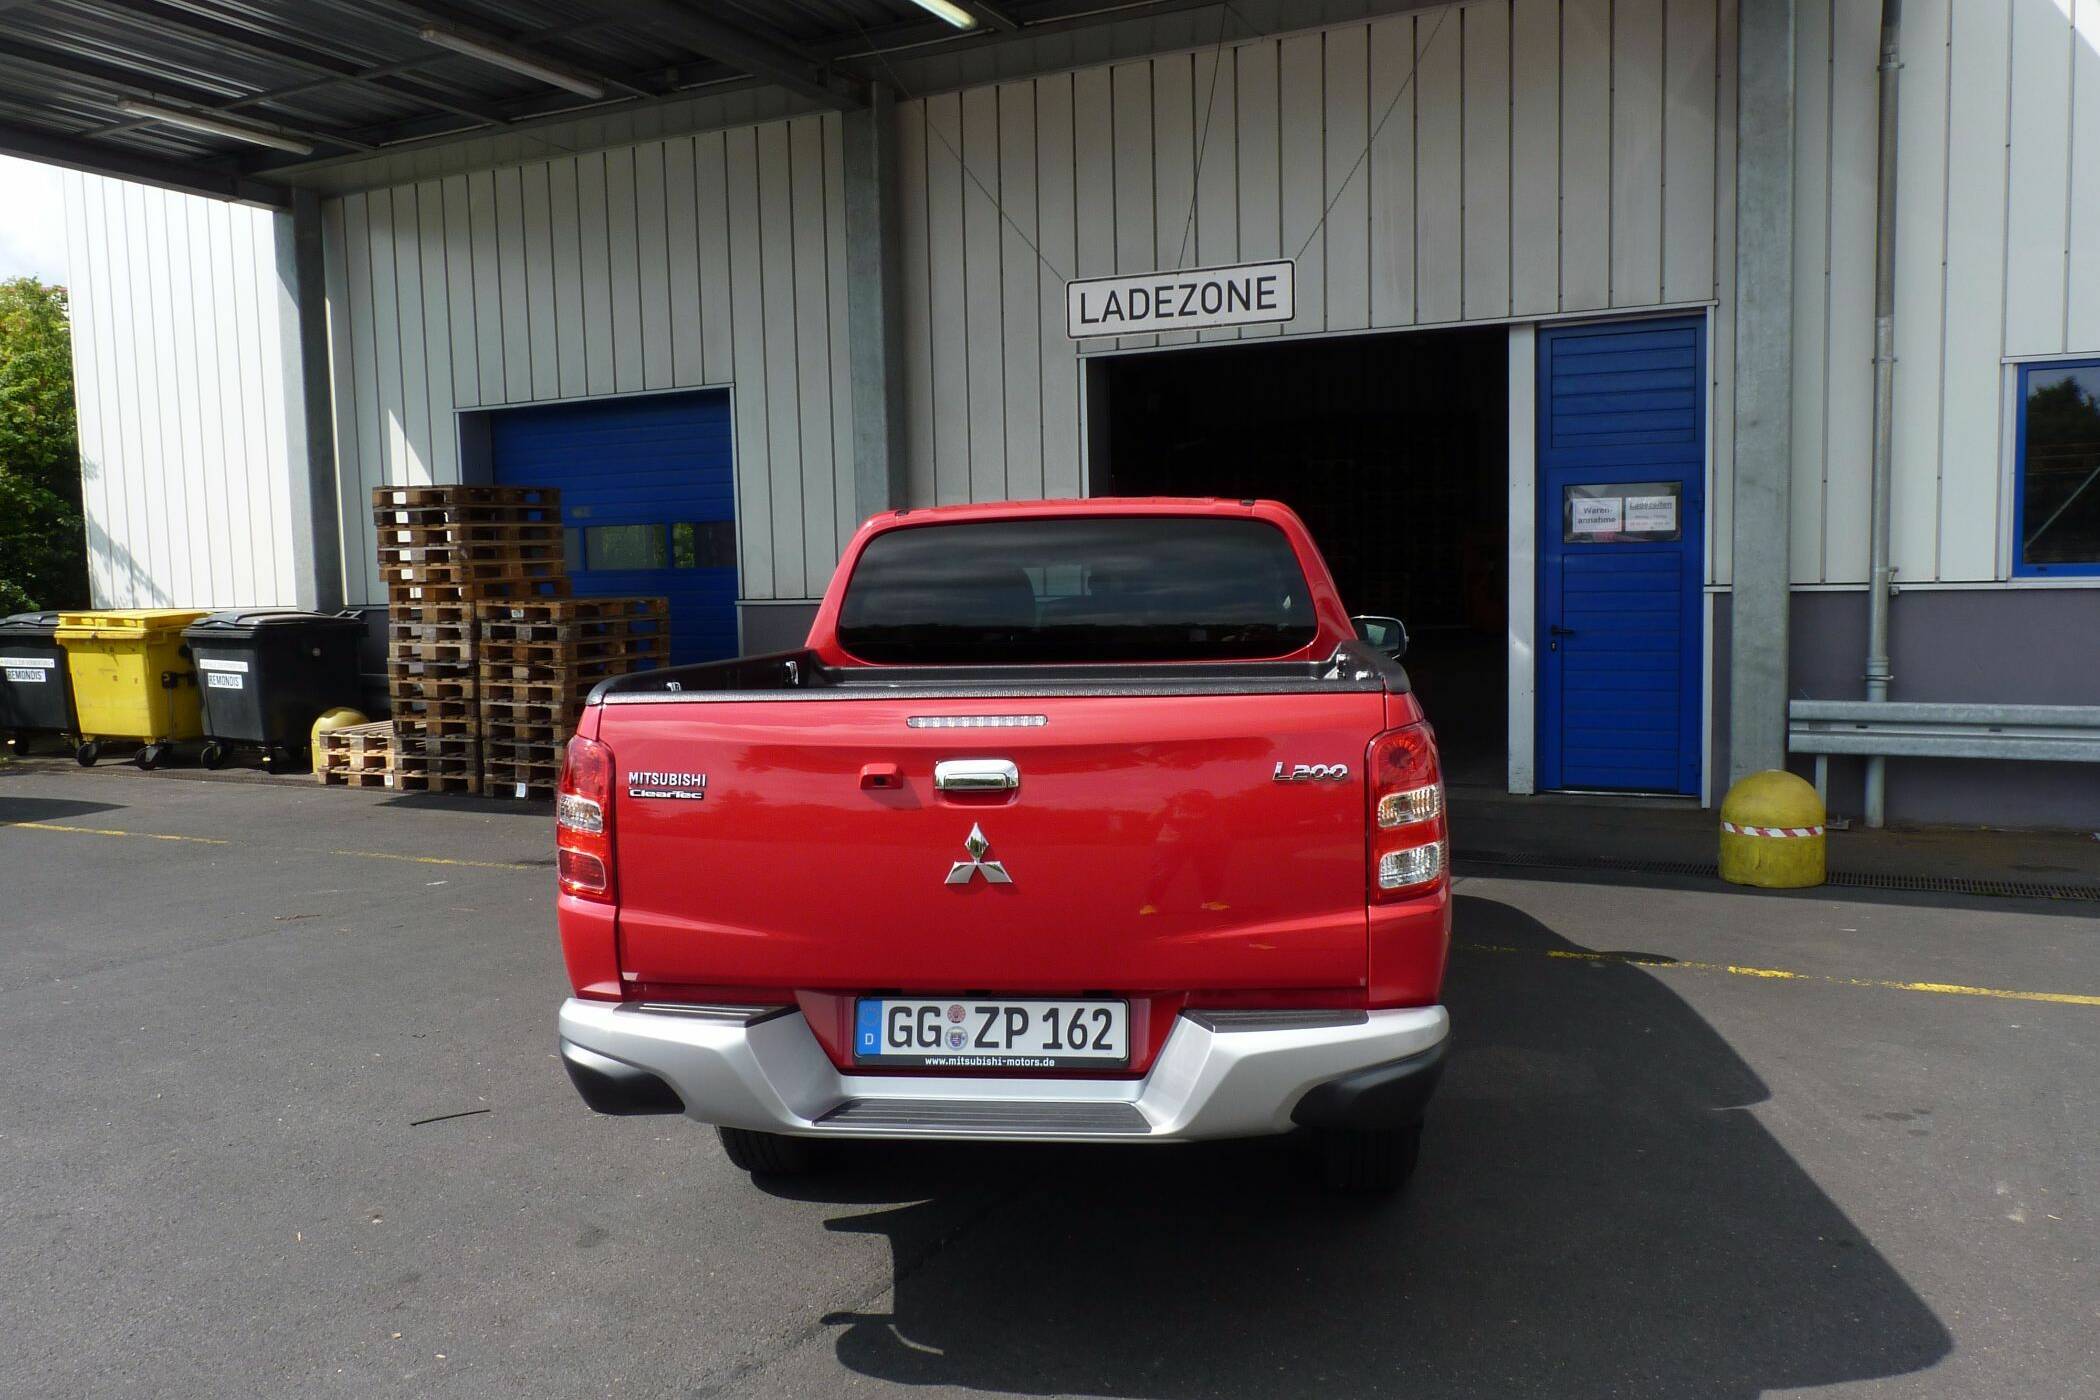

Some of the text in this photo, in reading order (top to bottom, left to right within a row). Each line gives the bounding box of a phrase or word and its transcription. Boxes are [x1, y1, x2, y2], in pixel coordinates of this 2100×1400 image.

[1080, 276, 1277, 325] LADEZONE
[1273, 761, 1348, 781] L200
[628, 772, 706, 787] MITSUBISHI
[629, 789, 703, 799] ClearTec
[887, 1006, 1113, 1051] GG ZP 162
[865, 1033, 874, 1045] D
[924, 1056, 1056, 1068] www.mitsubishi-motors.de
